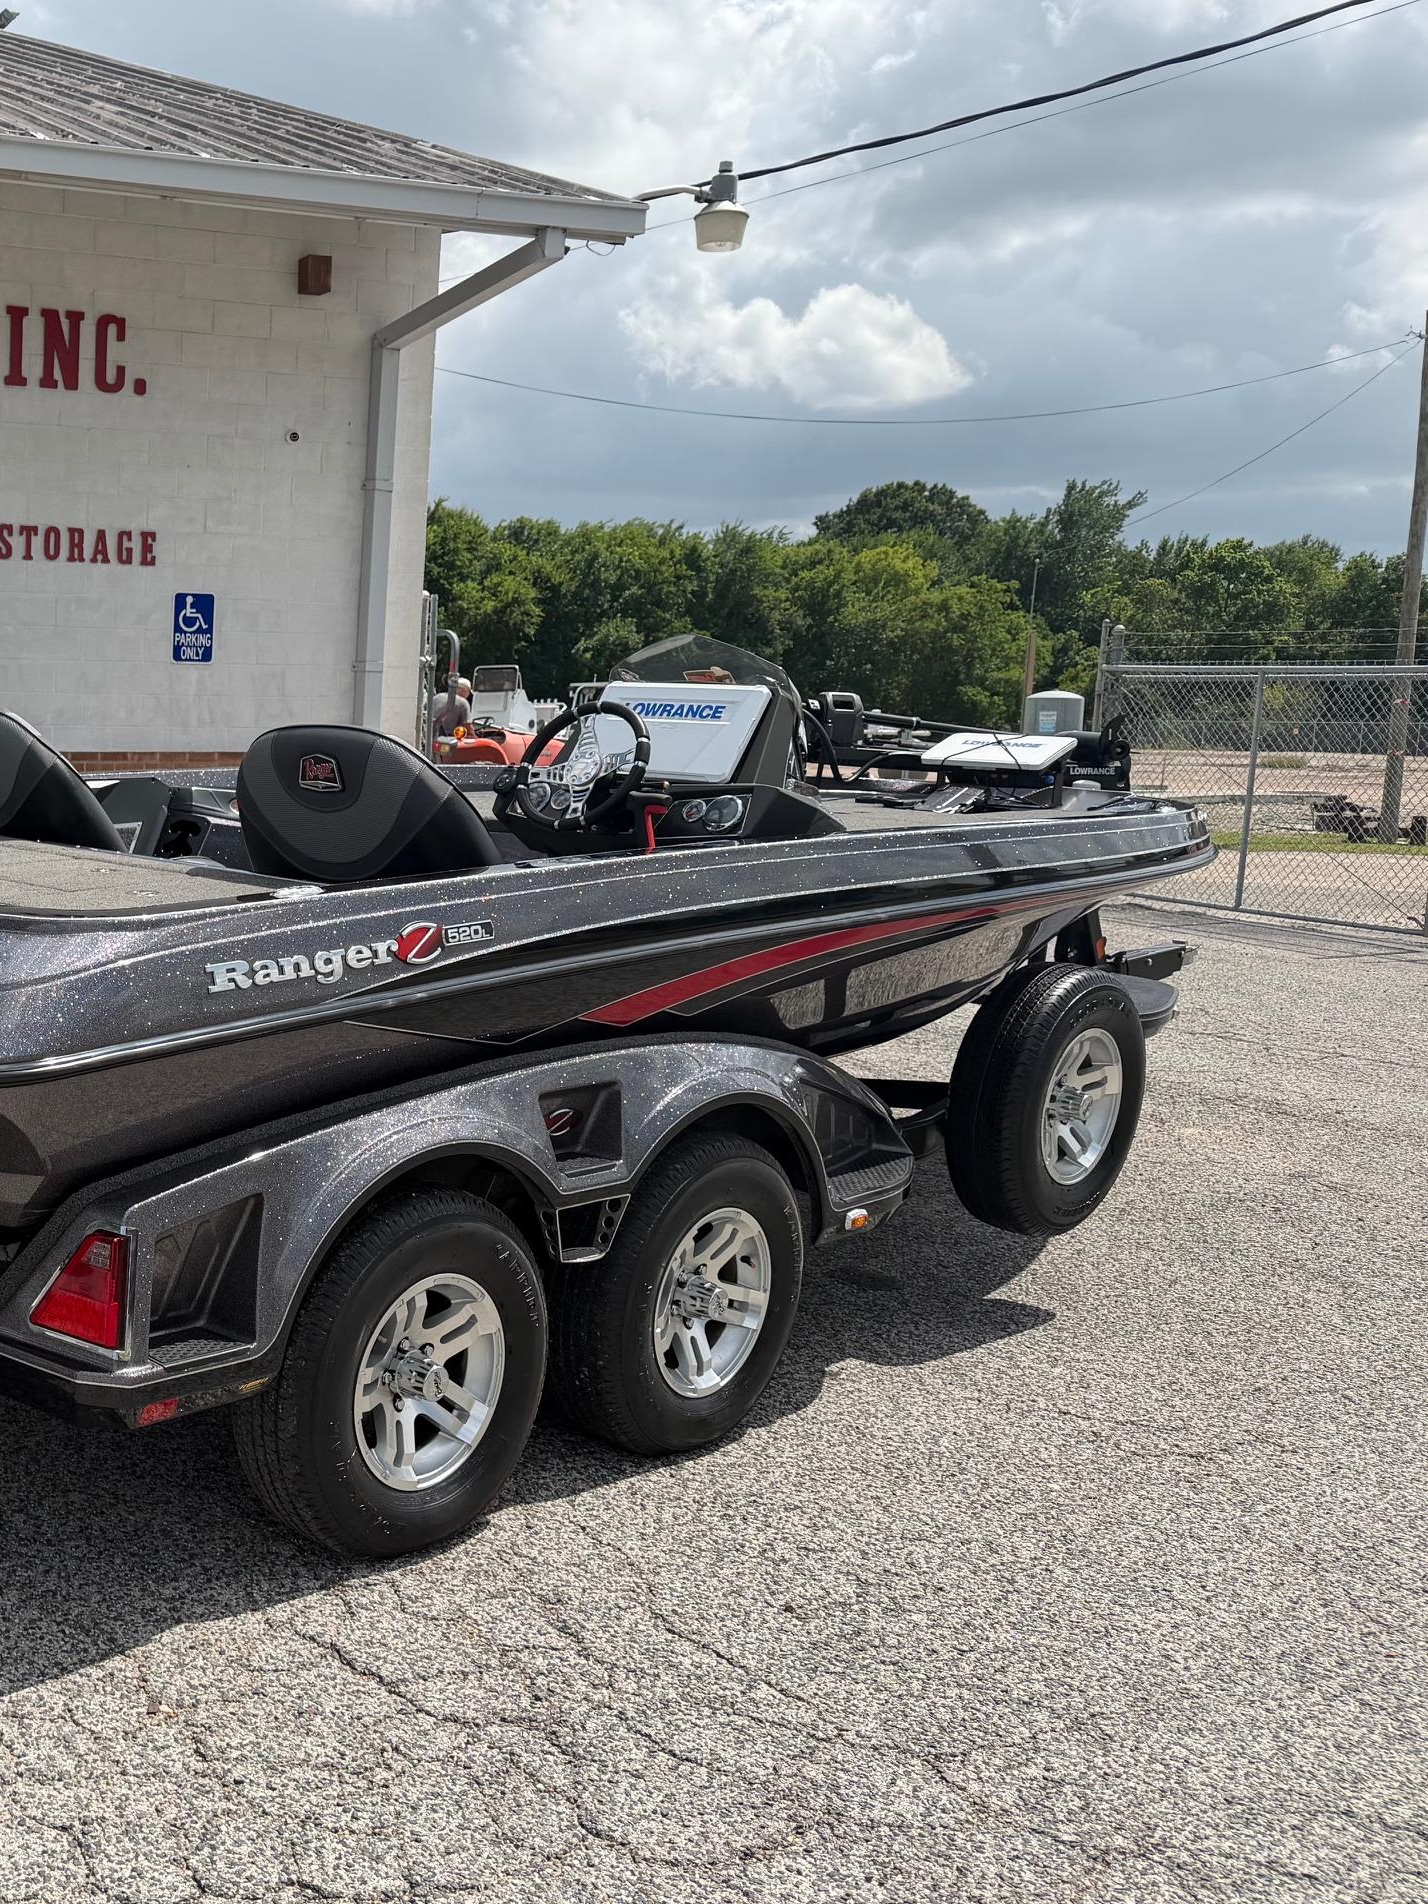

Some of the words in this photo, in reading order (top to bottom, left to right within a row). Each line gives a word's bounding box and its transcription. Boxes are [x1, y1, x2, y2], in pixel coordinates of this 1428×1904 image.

[4, 305, 147, 396] INC.
[174, 632, 211, 647] PARKING
[180, 646, 205, 660] ONLY
[626, 702, 726, 720] OWRANCE
[1069, 767, 1116, 775] LOWRANCE
[205, 938, 400, 994] Ranger
